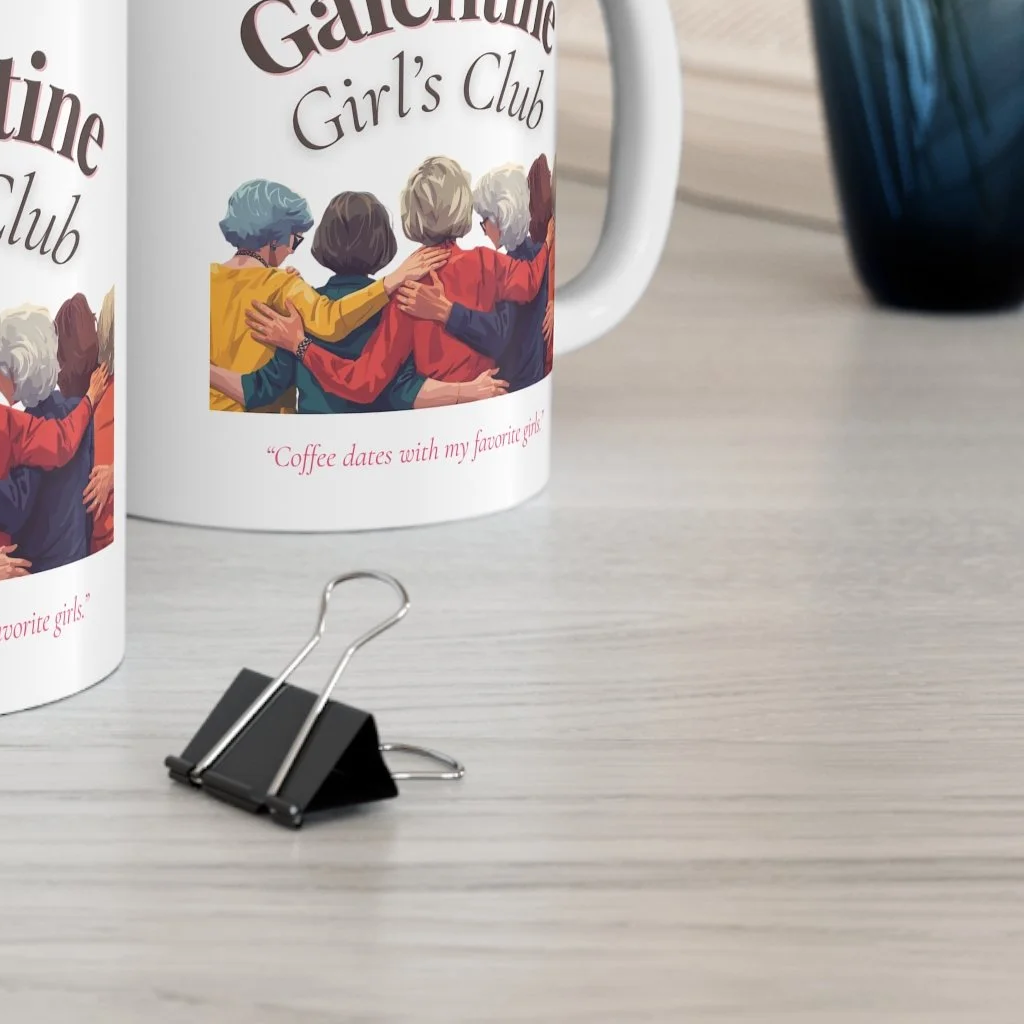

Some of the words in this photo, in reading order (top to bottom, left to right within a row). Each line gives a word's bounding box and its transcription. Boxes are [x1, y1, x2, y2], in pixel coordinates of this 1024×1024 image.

[292, 50, 443, 151] Girl’s
[463, 49, 545, 130] Club
[266, 443, 336, 476] “Coffee
[342, 443, 393, 466] dates
[400, 437, 439, 464] with
[445, 442, 469, 465] my
[471, 427, 521, 461] favorite
